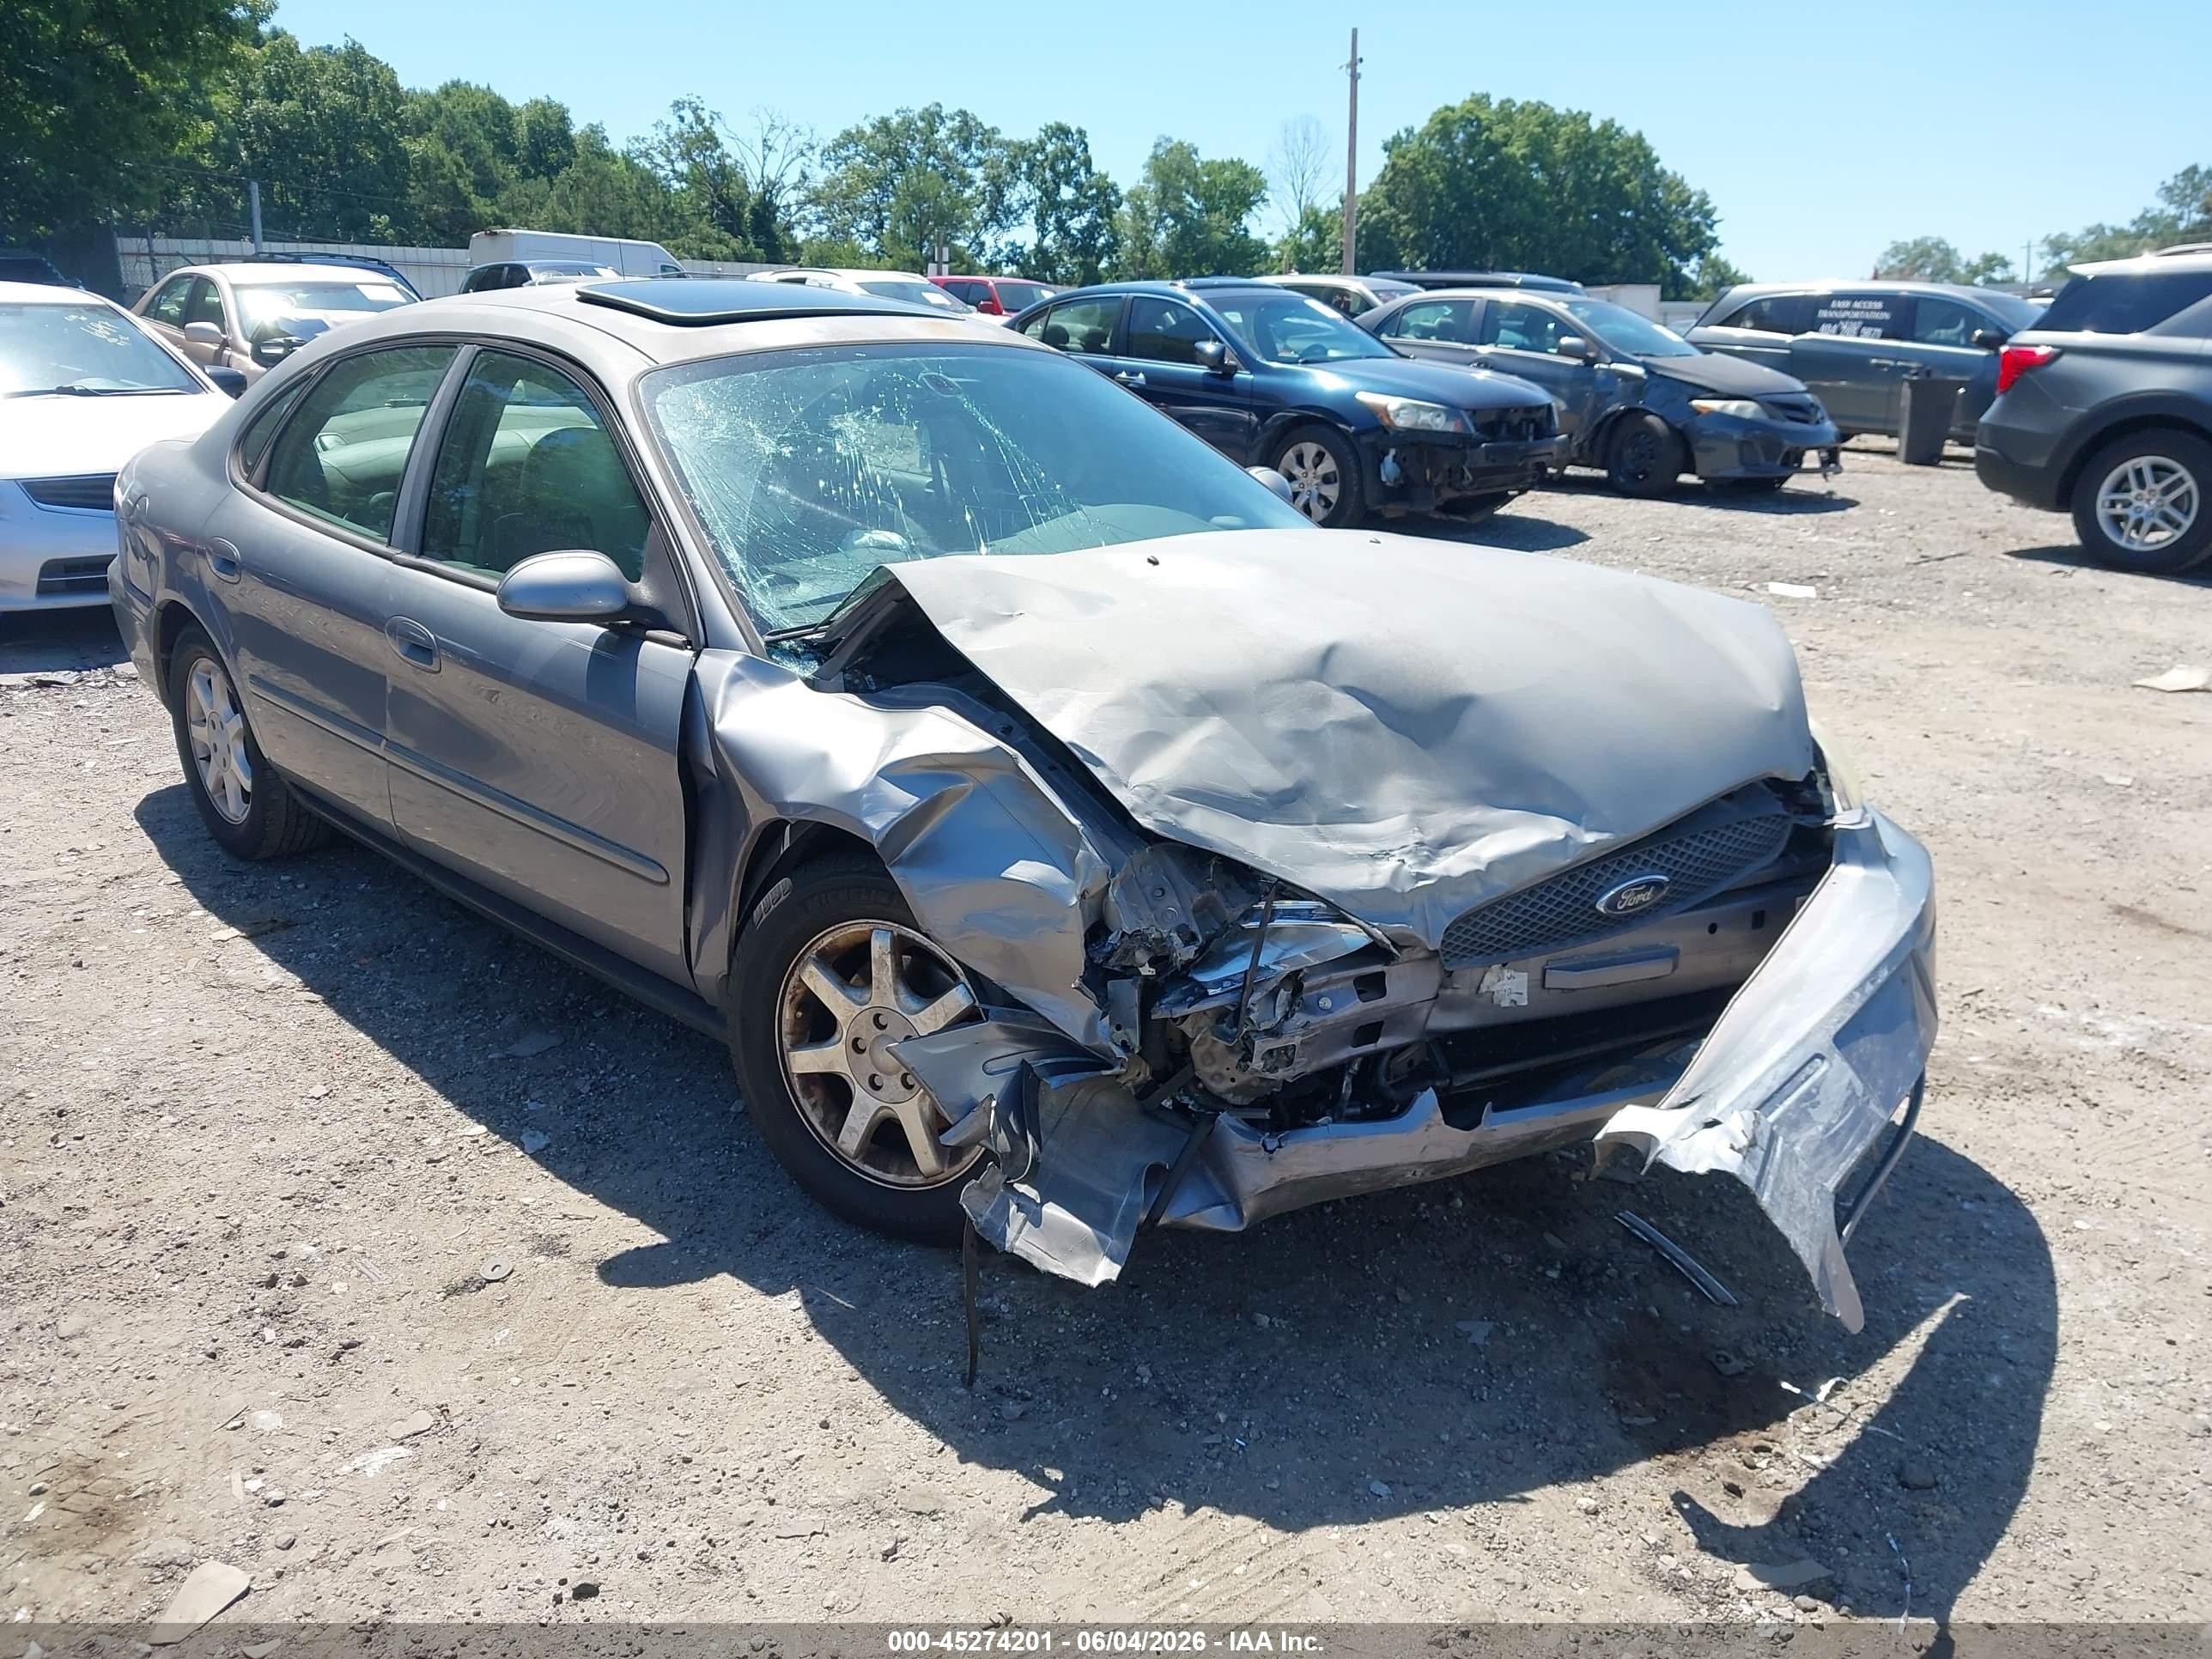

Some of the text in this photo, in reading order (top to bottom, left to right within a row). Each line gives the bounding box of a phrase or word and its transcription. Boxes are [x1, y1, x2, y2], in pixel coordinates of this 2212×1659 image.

[1852, 300, 1884, 310] ACCESS
[1817, 309, 1892, 320] TRANSPORTATION
[1617, 884, 1655, 910] Ford
